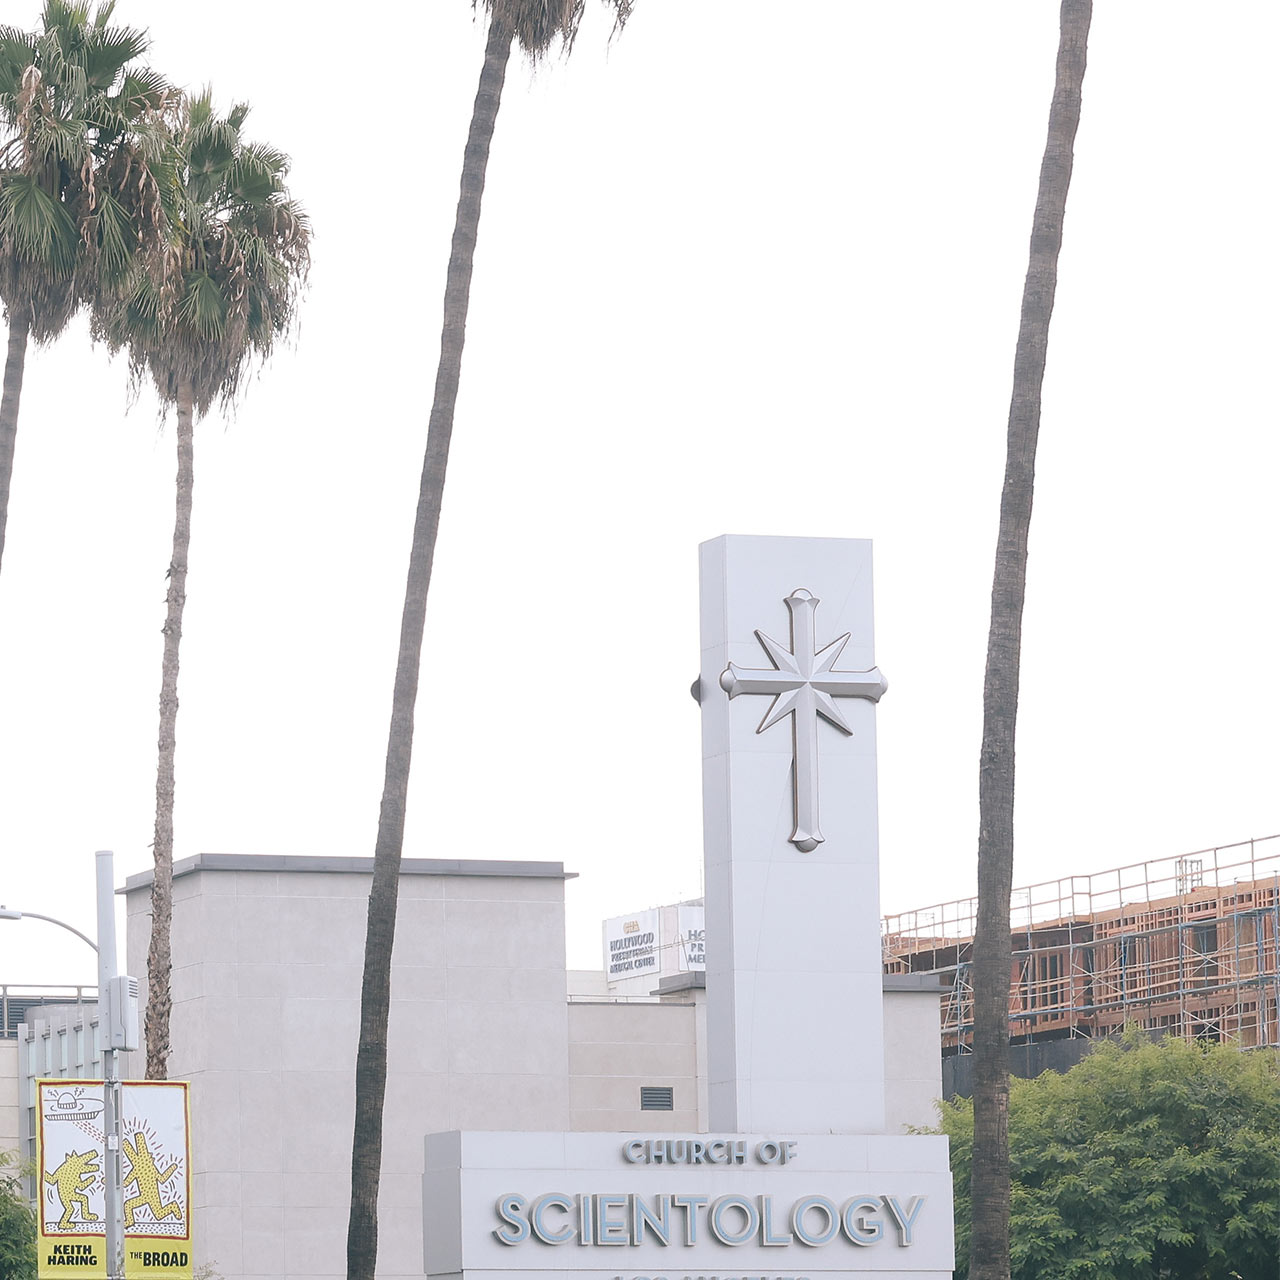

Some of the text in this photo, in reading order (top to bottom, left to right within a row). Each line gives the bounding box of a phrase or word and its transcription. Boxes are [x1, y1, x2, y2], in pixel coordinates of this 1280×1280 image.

[610, 933, 654, 951] HOLLYWOOD
[622, 1140, 798, 1165] CHURCH OF
[492, 1193, 927, 1247] SCIENTOLOGY
[54, 1245, 92, 1255] KEITH
[47, 1255, 97, 1266] HARING
[143, 1252, 188, 1267] BROAD
